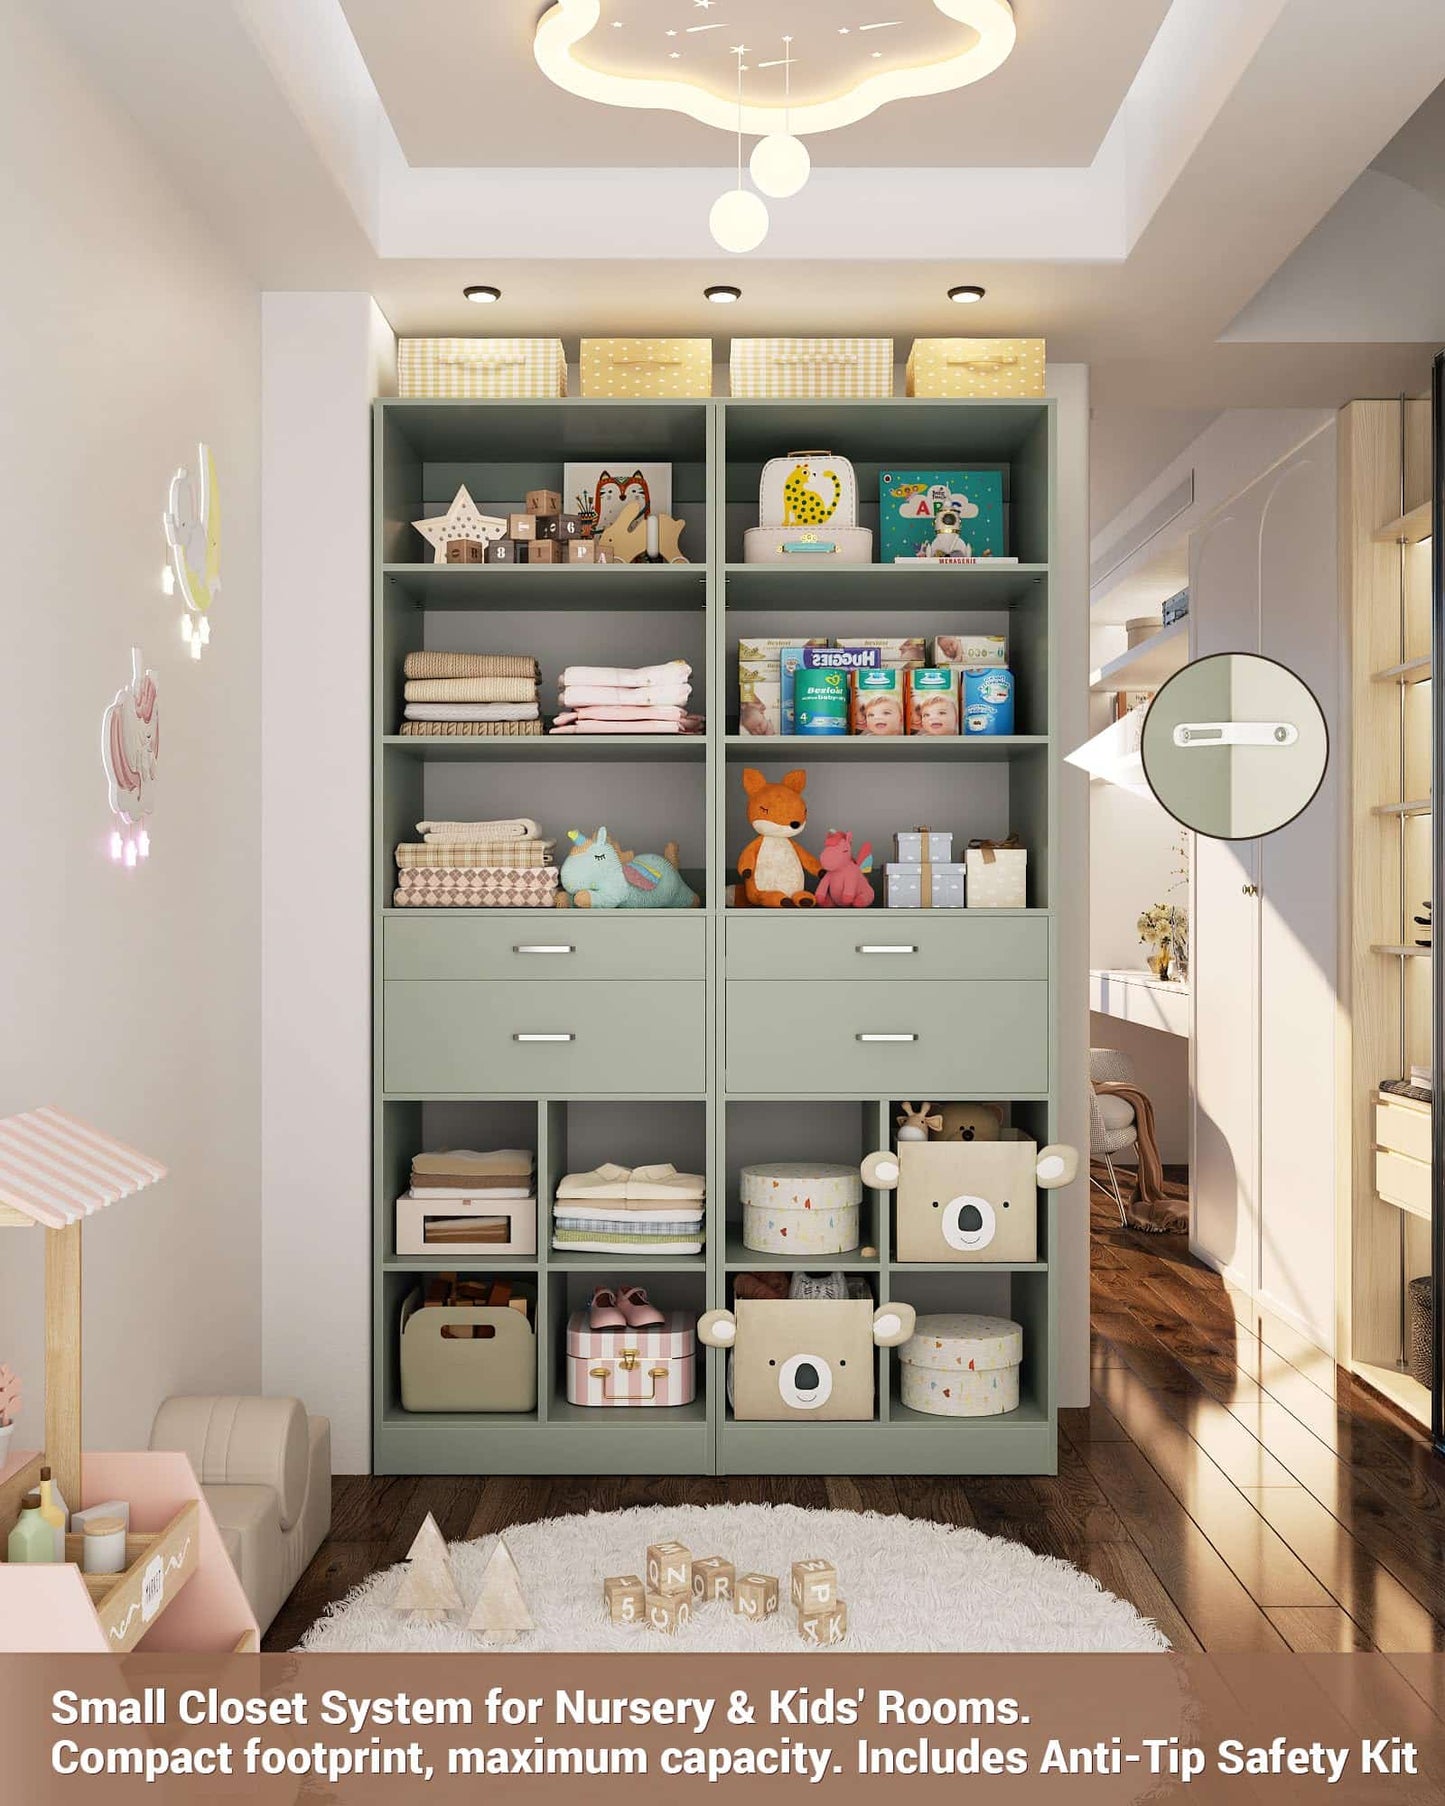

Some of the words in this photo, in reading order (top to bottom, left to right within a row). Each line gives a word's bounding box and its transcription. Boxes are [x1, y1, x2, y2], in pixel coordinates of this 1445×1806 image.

[567, 521, 575, 534] 6
[497, 547, 506, 558] 8
[577, 546, 587, 558] P
[800, 712, 807, 721] 4
[667, 1563, 686, 1585] N
[714, 1576, 730, 1600] R
[810, 1583, 830, 1603] P
[621, 1596, 635, 1621] 5
[829, 1614, 843, 1641] K
